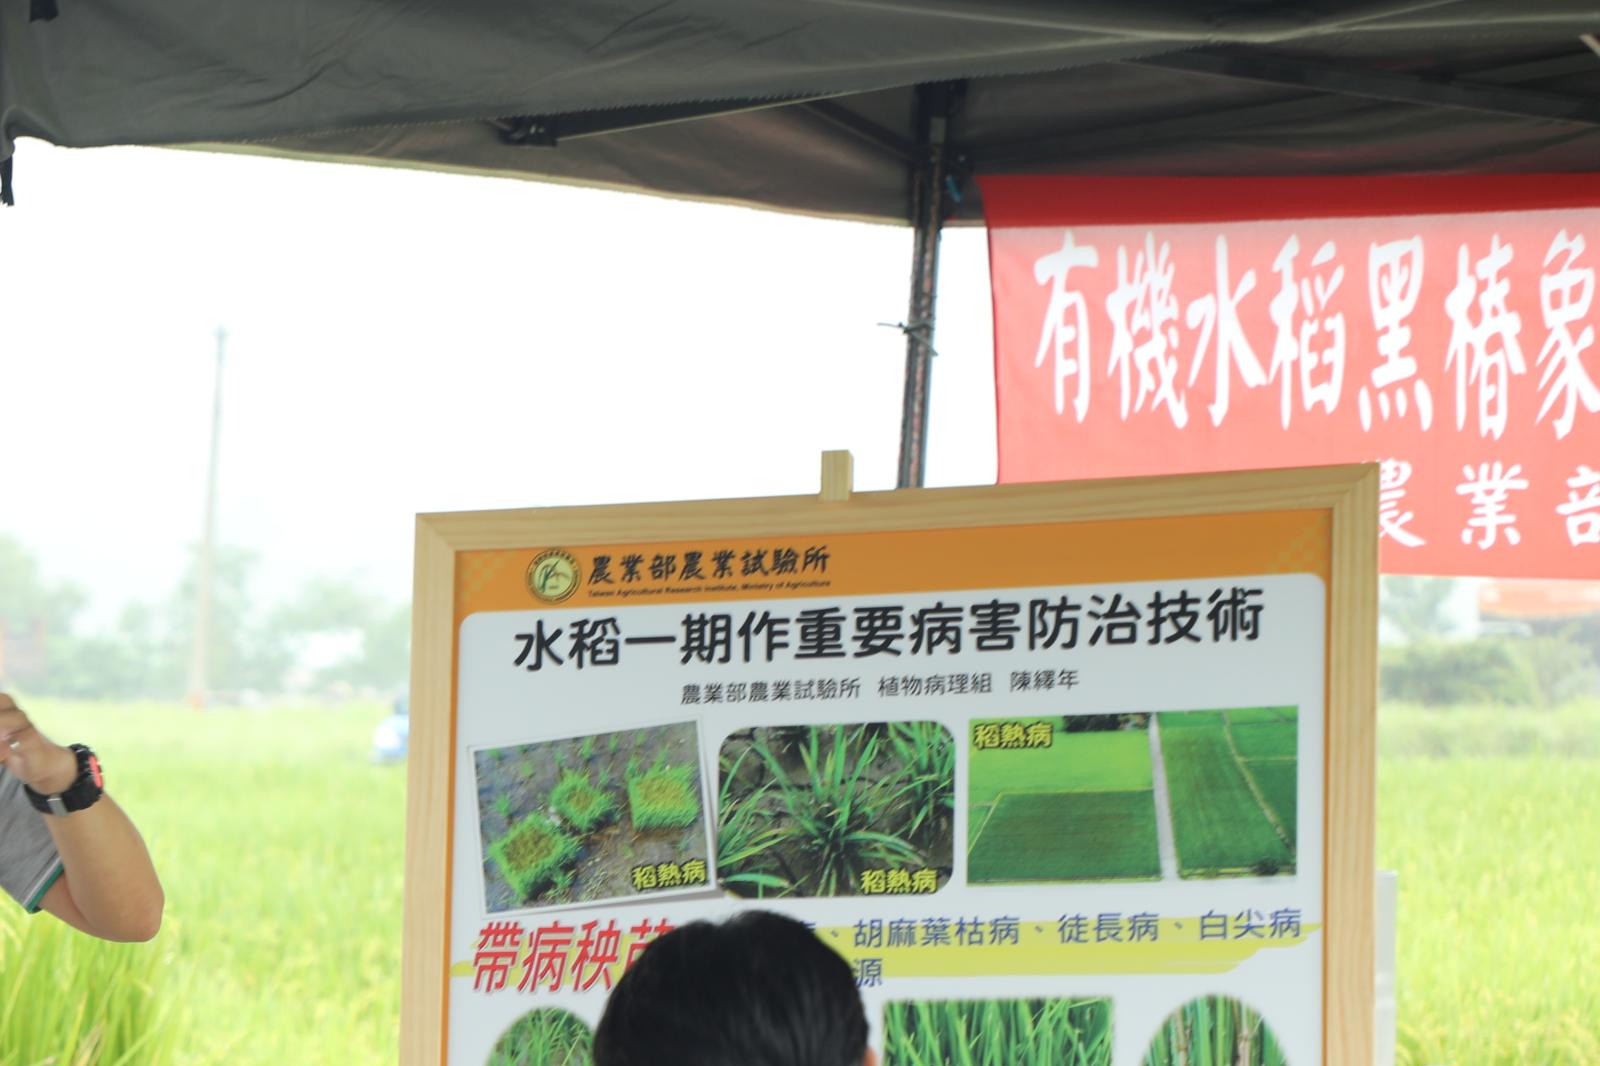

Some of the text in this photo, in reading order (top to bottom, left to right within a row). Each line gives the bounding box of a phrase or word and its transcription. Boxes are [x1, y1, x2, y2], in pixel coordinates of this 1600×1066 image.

[588, 545, 831, 586] 農業部農業試驗所
[513, 587, 1264, 672] 水稻一期作重要病害防治技術
[681, 677, 861, 705] 農業部農業試驗所
[878, 671, 992, 697] 植物病理組
[973, 721, 1053, 750] 稻熱病
[632, 858, 707, 892] 稻熱病
[860, 867, 938, 895] 稻熱病
